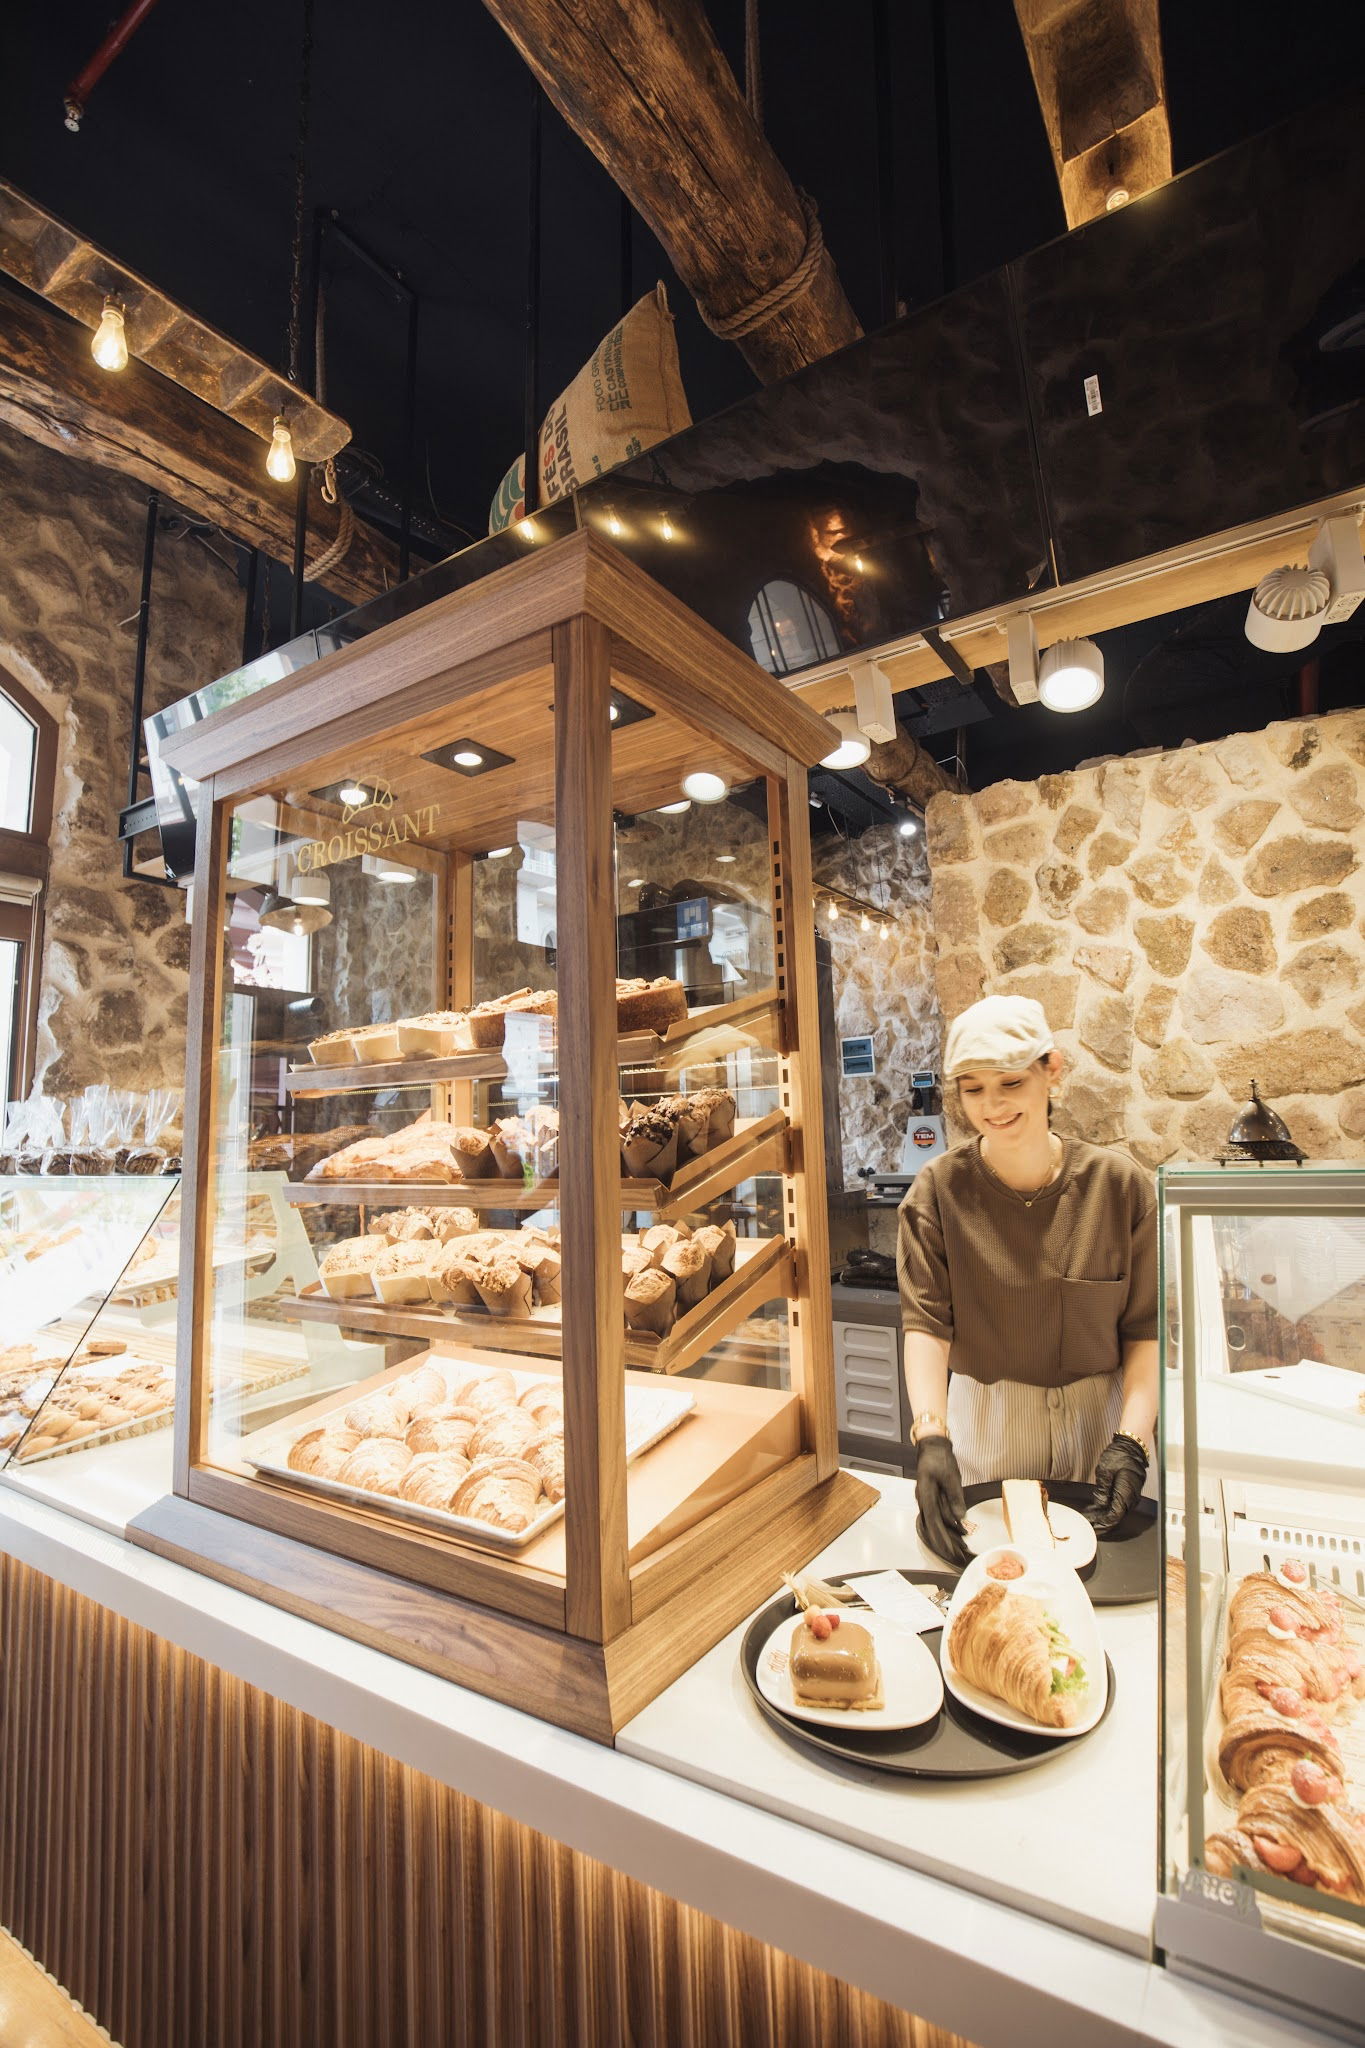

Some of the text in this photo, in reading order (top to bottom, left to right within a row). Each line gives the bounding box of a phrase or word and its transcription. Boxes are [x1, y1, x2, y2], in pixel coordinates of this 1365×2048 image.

[593, 380, 606, 412] FOOD
[543, 408, 562, 500] FÉS DO
[554, 402, 579, 496] BRASIL
[297, 803, 440, 873] CROISSANT
